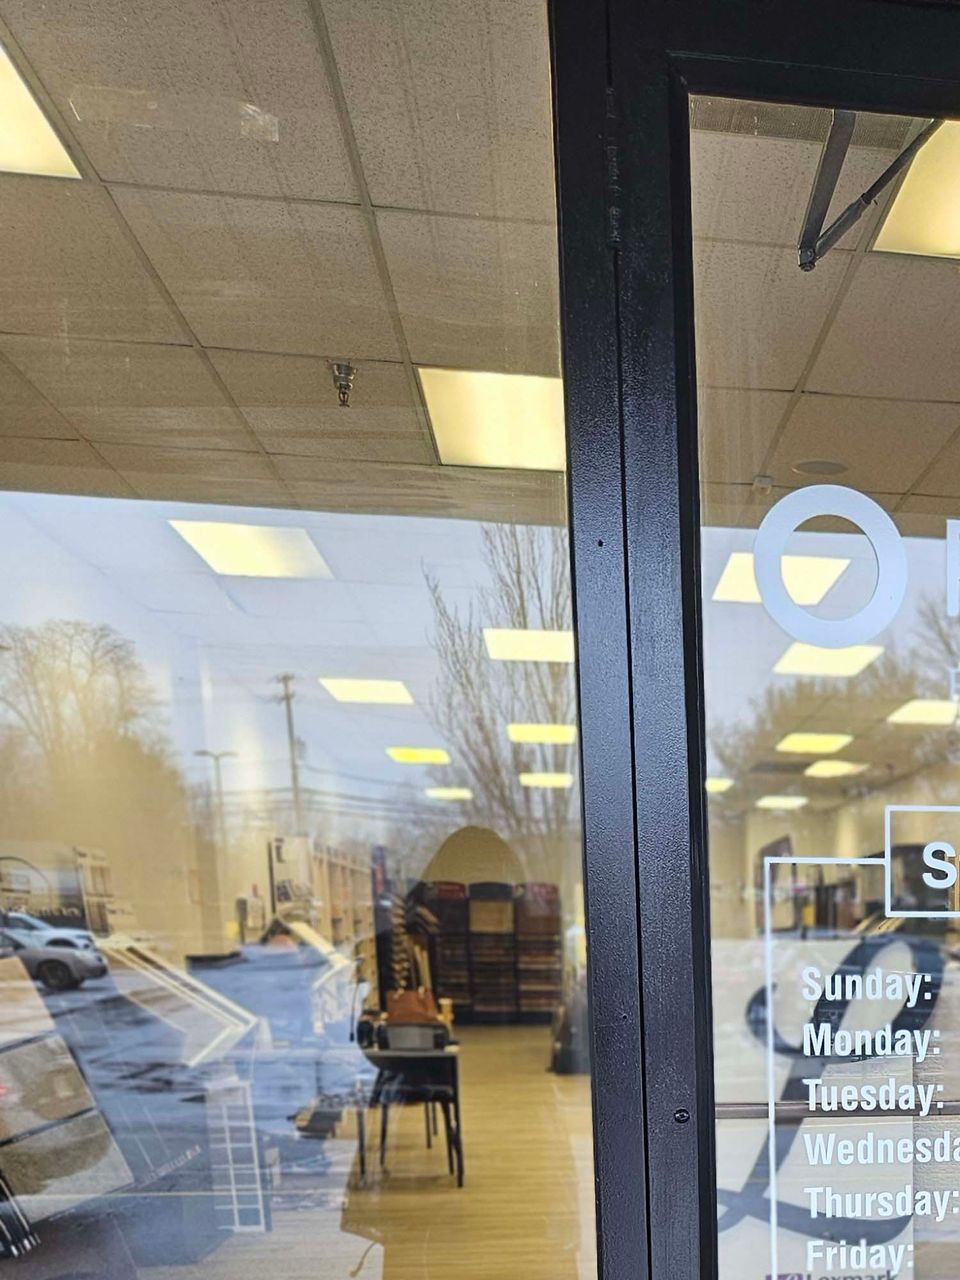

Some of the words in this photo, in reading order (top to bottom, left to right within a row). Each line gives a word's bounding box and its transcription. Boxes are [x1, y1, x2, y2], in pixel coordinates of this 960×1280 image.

[802, 966, 932, 1007] Sunday:
[801, 1022, 941, 1062] Monday:
[801, 1077, 945, 1117] Tuesday:
[804, 1184, 960, 1222] Thursday:
[806, 1238, 914, 1276] Friday:
